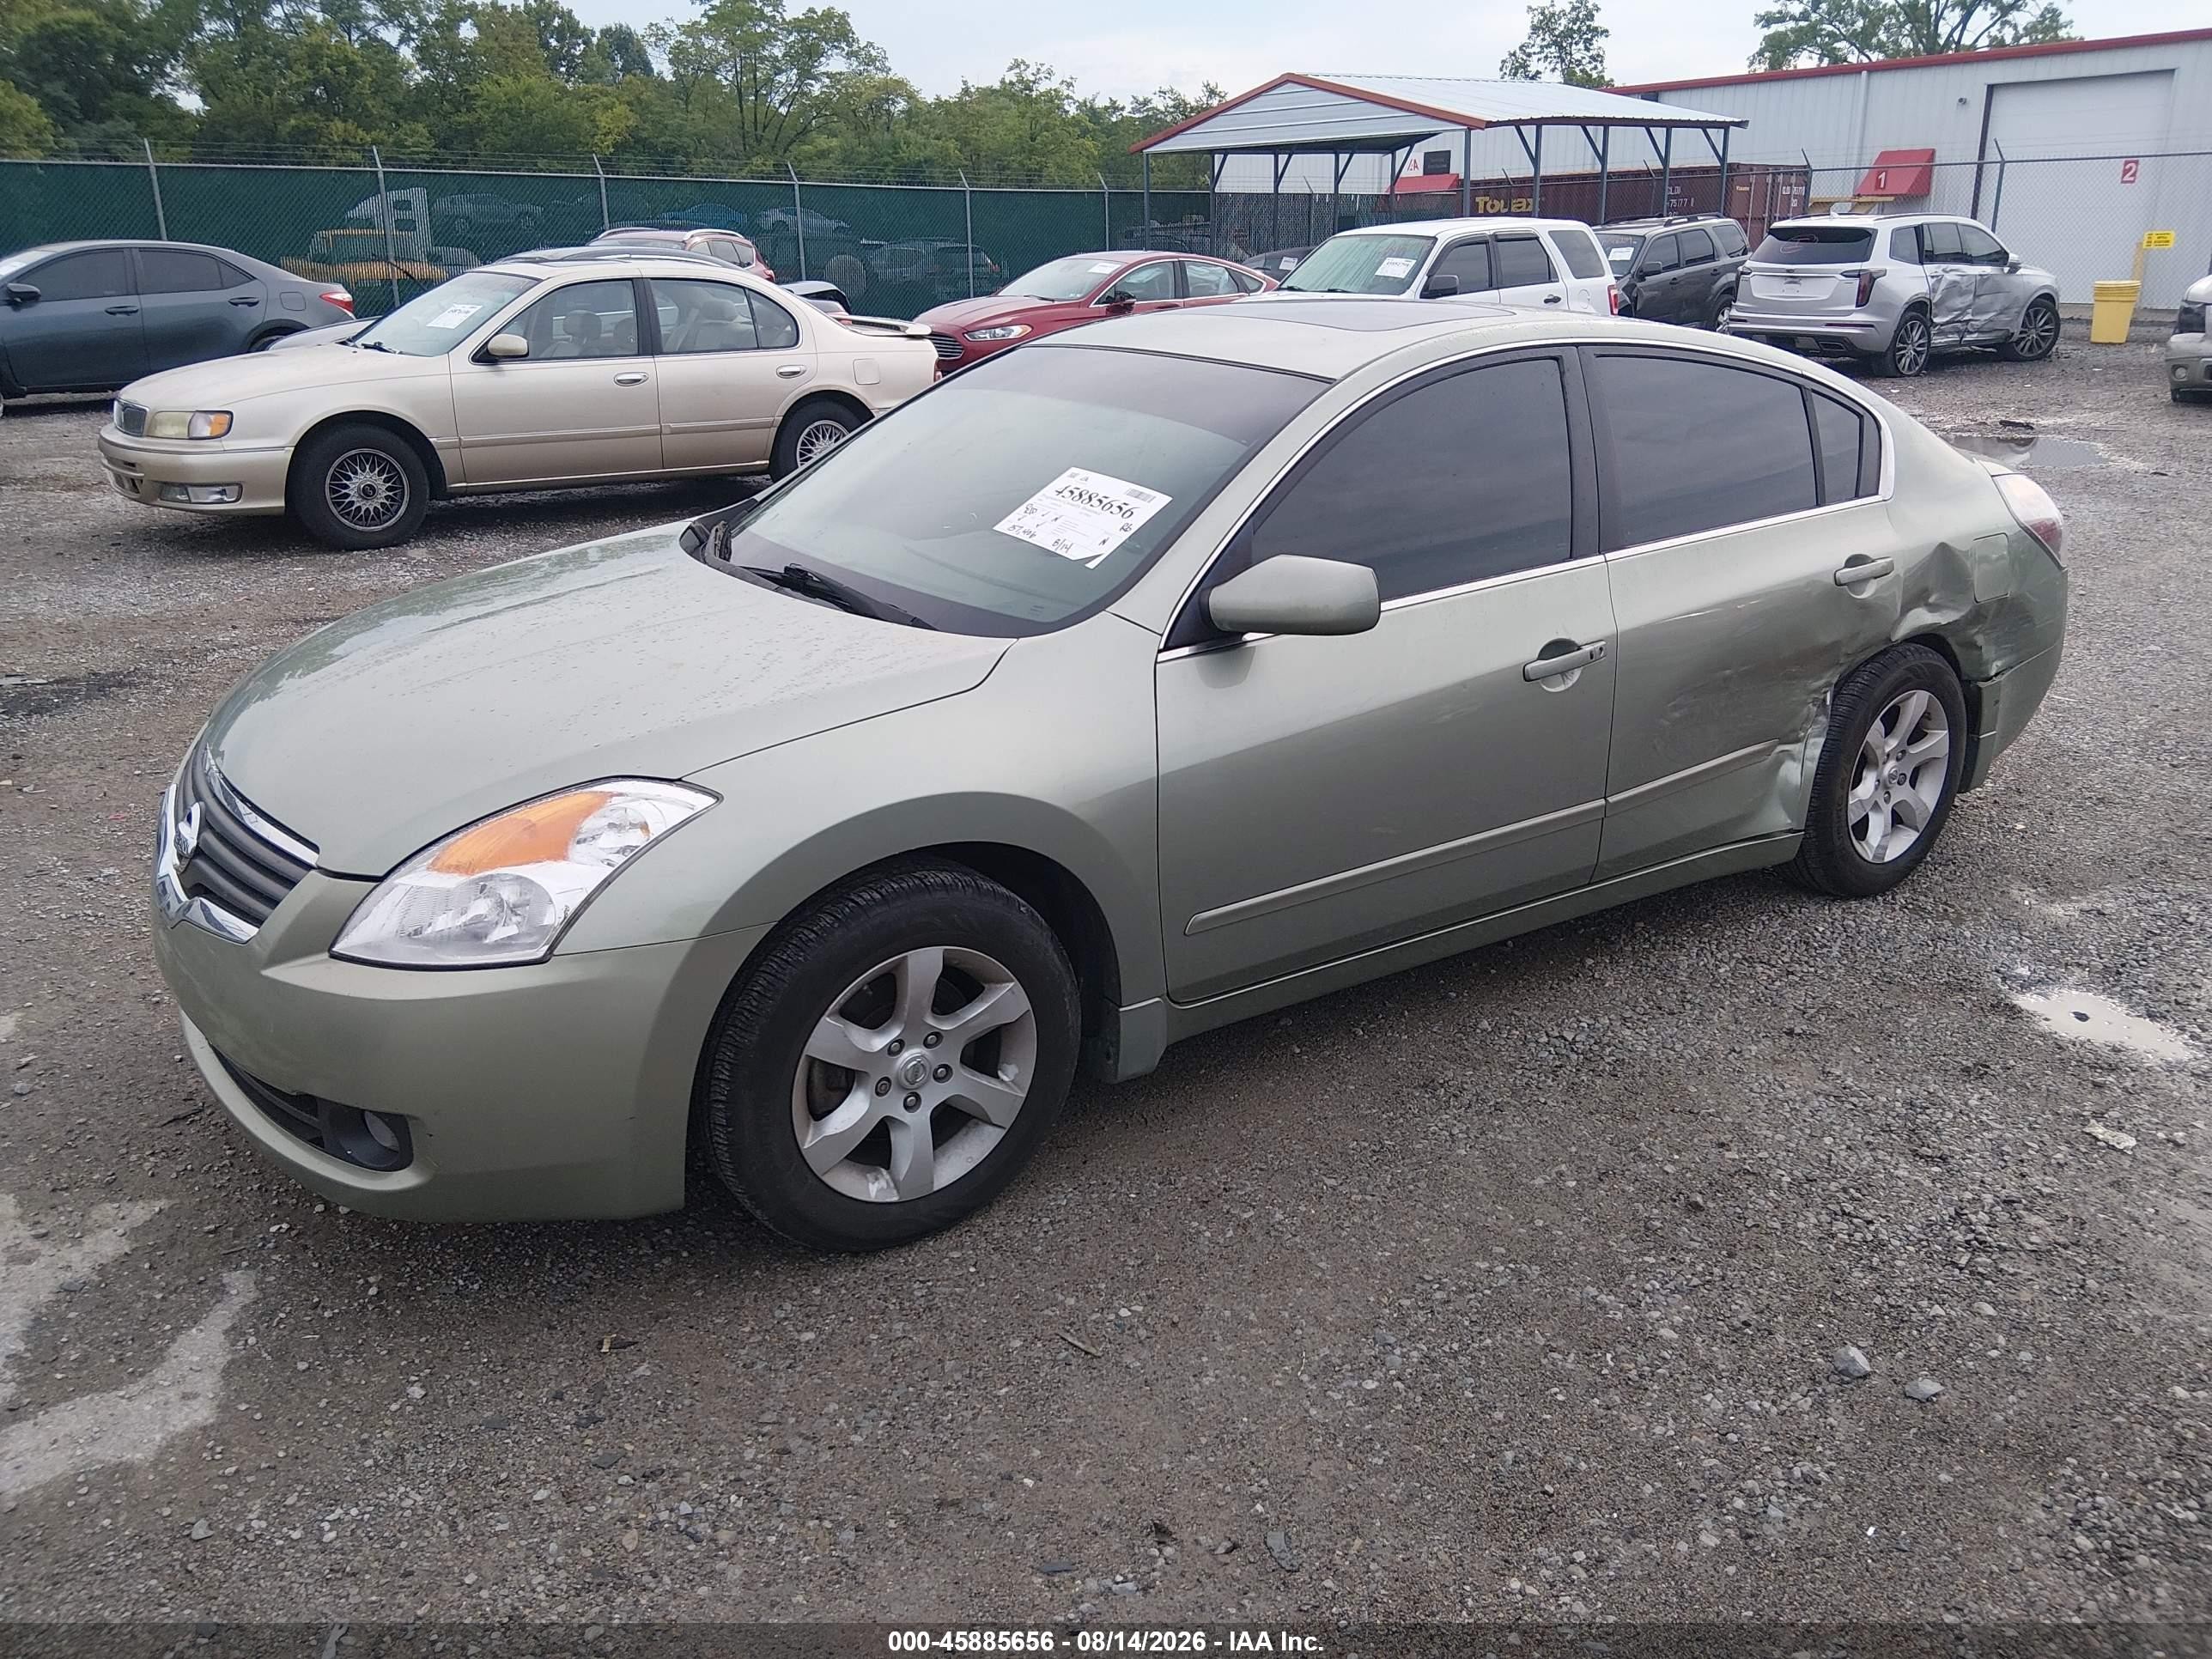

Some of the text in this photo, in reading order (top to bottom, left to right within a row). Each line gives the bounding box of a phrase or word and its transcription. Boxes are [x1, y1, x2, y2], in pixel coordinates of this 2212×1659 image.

[1878, 171, 1886, 188] 1
[2123, 162, 2137, 181] 2
[1054, 484, 1140, 520] 45885656
